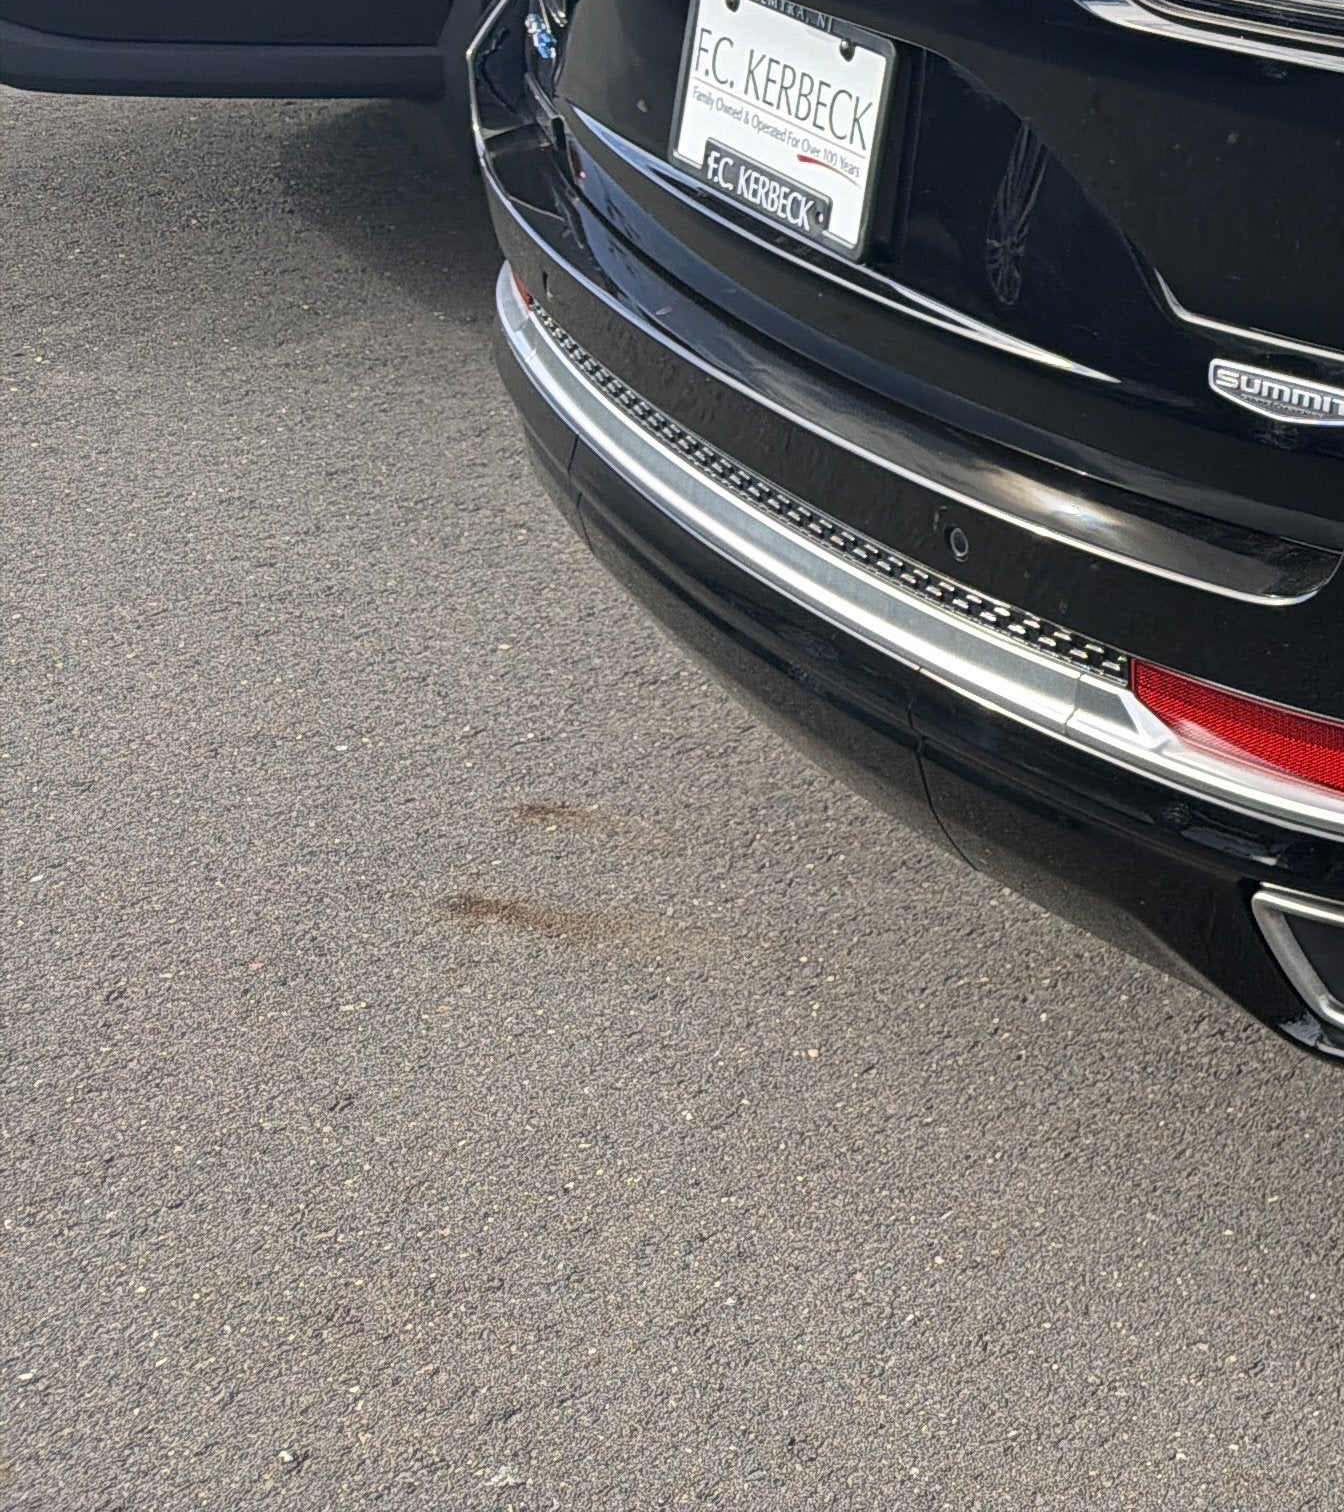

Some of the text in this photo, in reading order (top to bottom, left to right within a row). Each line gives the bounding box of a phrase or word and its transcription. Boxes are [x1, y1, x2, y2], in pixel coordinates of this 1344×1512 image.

[692, 85, 861, 178] Family Owned & Operated For Over 100 Years
[694, 27, 874, 150] F.C. KERBECK
[706, 150, 816, 232] F.C. KERBECK
